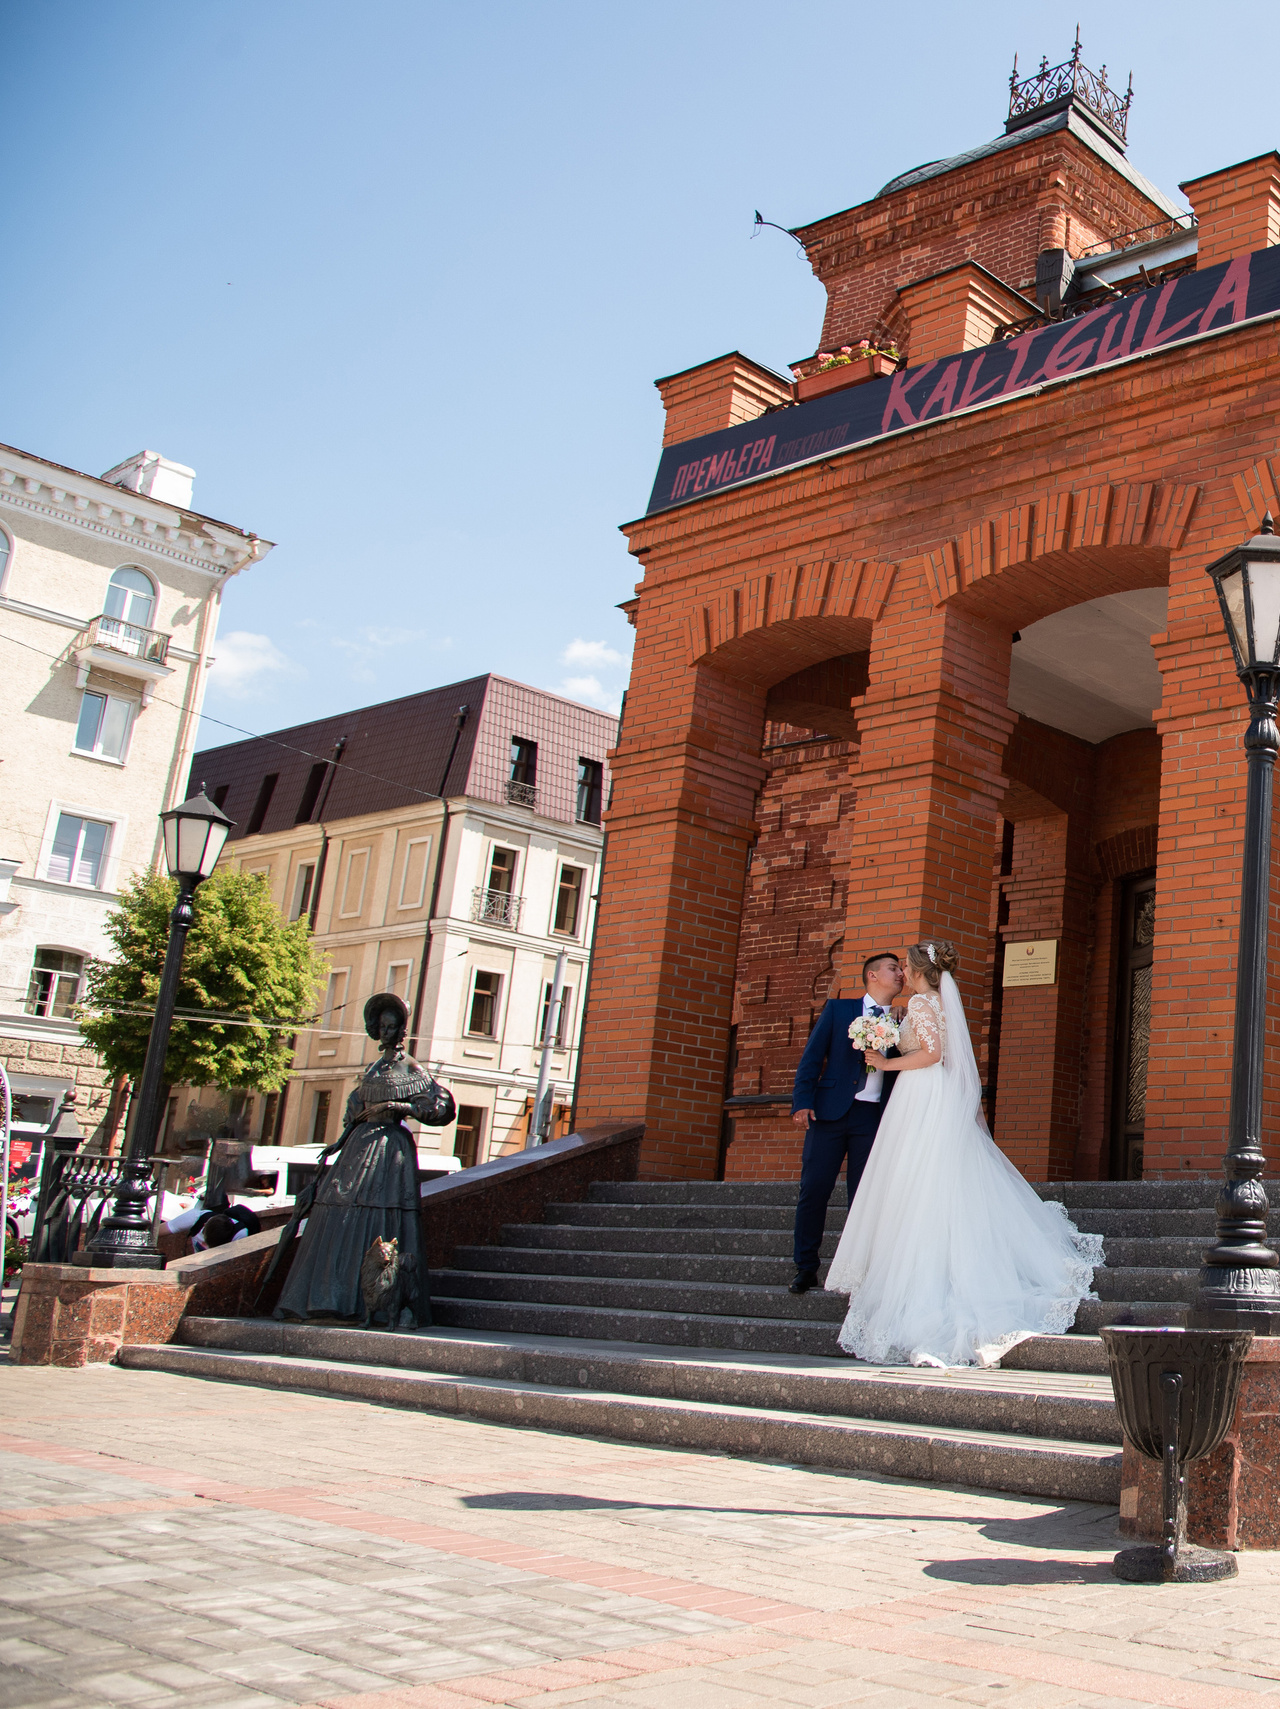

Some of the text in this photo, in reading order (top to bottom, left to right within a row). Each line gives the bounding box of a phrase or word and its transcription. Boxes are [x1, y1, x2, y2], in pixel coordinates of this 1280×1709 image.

[881, 253, 1252, 434] KALIGULA
[669, 422, 850, 501] ПРЕМЬЕРА СПЕКТАКЛЯ
